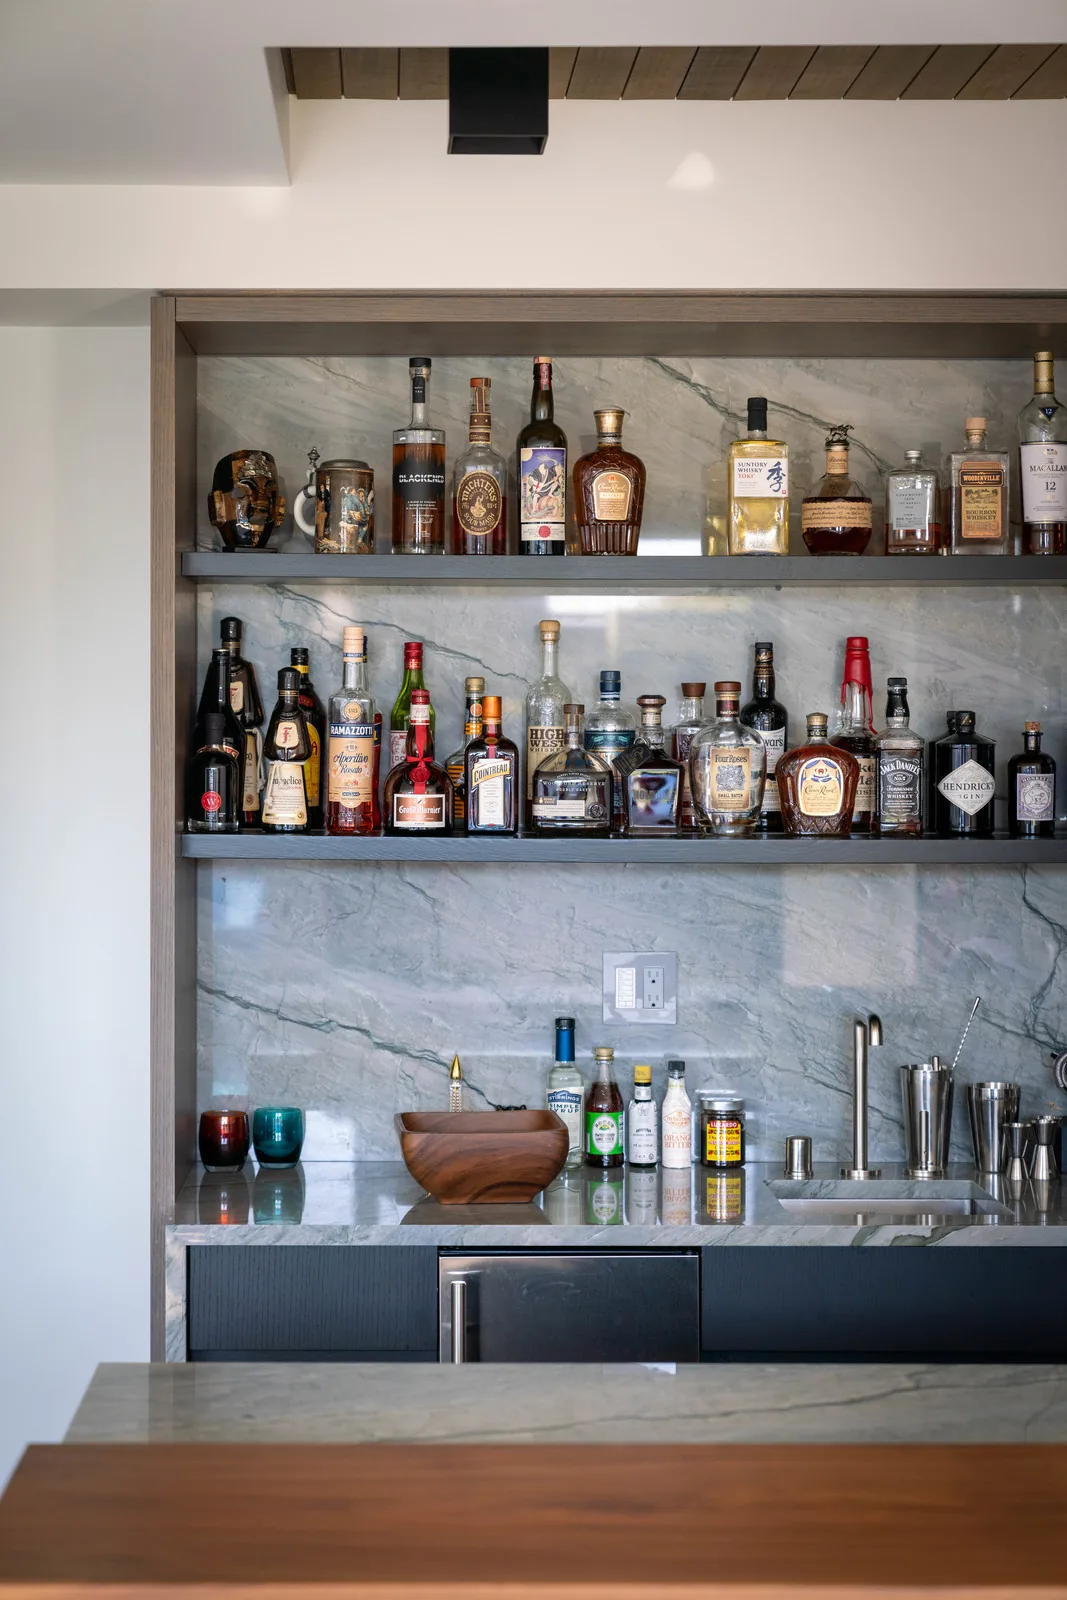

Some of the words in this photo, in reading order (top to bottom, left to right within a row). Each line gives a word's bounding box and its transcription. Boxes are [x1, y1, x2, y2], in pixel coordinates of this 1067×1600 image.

[1044, 481, 1057, 491] 12
[330, 725, 373, 736] RAMAZZOTTI
[530, 728, 565, 740] HIGH
[530, 740, 565, 748] WEST
[333, 750, 369, 768] Aperitivo
[715, 754, 730, 763] Four
[730, 754, 748, 763] Roses
[474, 763, 508, 783] COINTREAU
[880, 762, 897, 776] JACK
[896, 760, 920, 776] DANIEL'S
[943, 782, 995, 791] HENDRICK'S
[664, 1134, 691, 1142] ORANG
